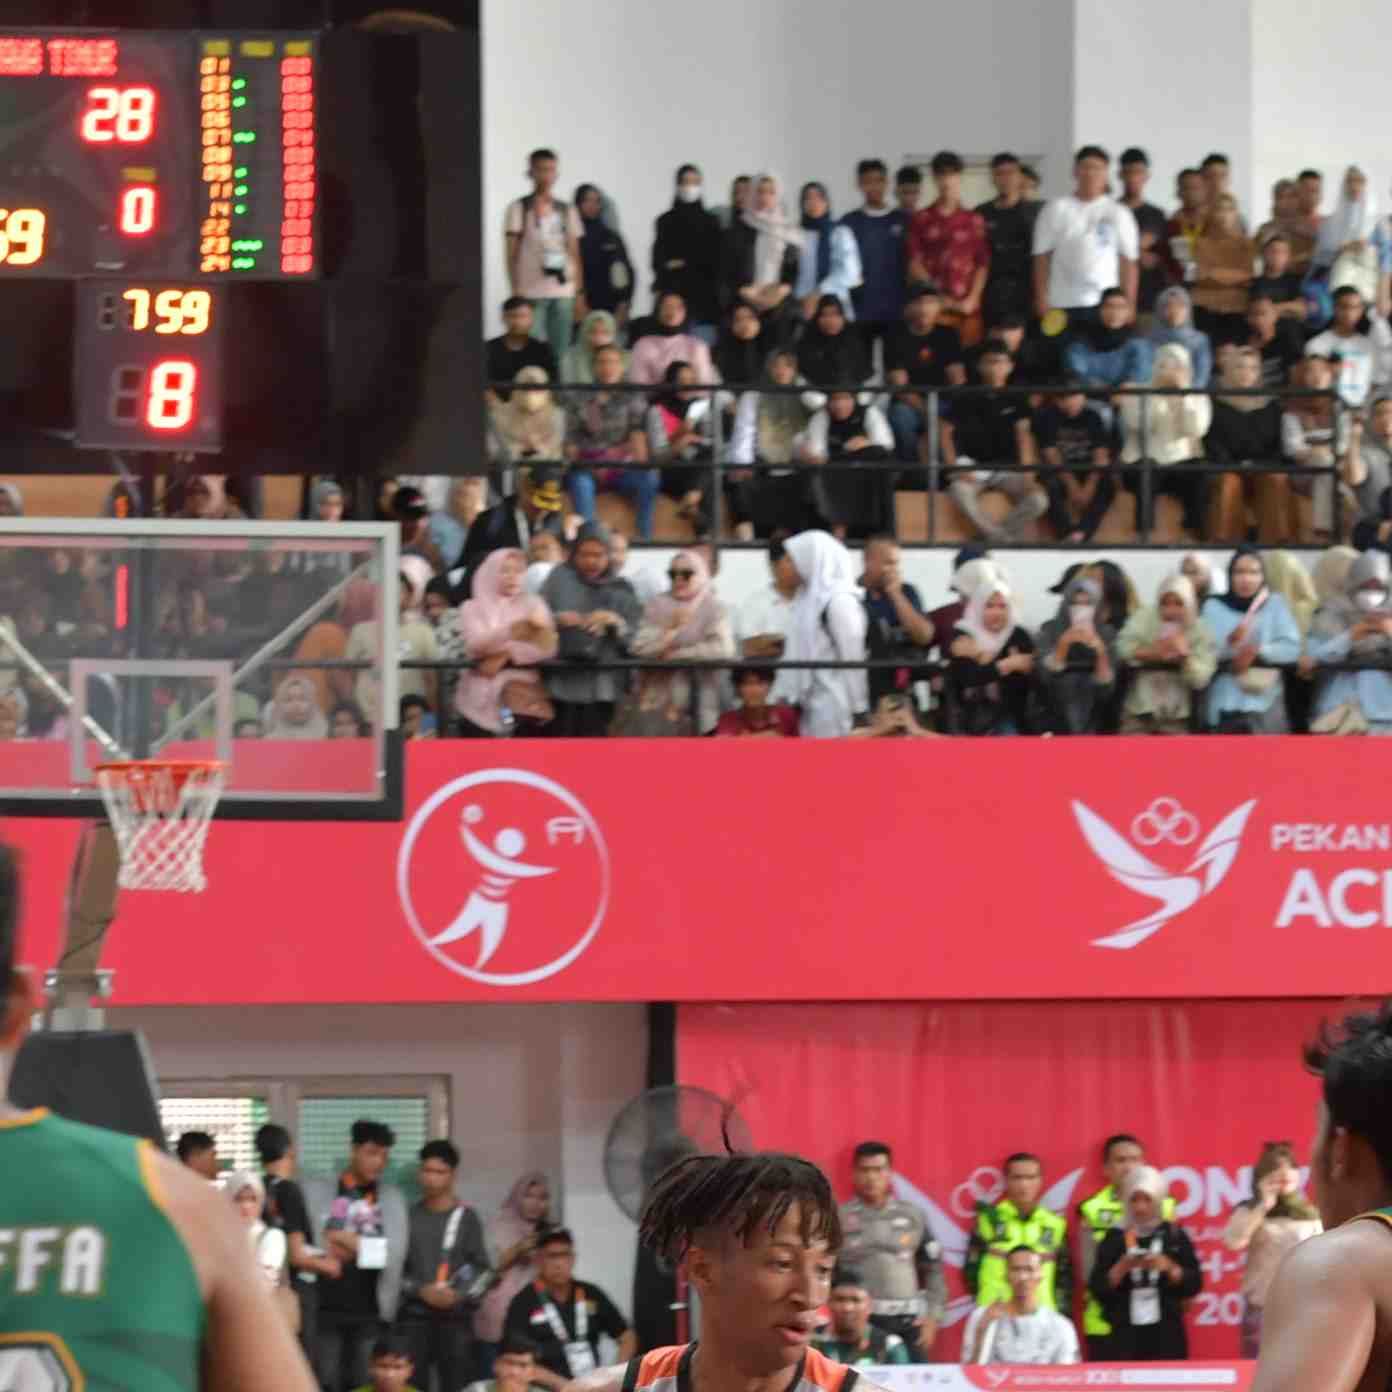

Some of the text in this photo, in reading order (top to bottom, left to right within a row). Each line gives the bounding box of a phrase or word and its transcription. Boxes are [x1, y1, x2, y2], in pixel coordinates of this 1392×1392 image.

[82, 87, 156, 141] 28
[119, 187, 156, 234] 0
[146, 361, 197, 429] 8
[1271, 823, 1390, 852] PEKAN
